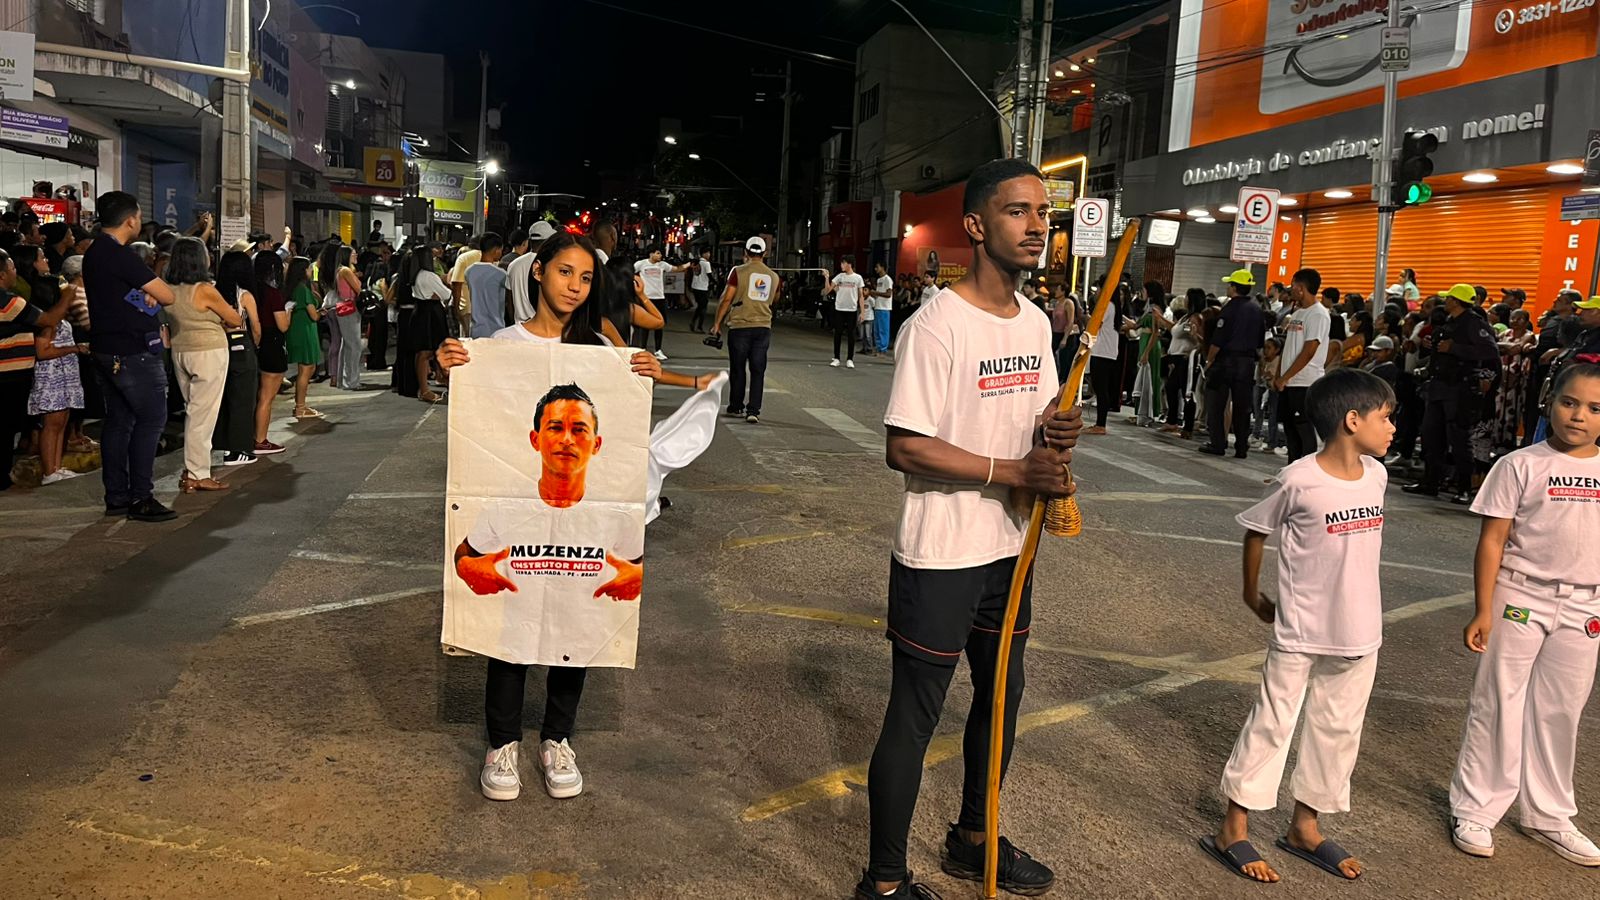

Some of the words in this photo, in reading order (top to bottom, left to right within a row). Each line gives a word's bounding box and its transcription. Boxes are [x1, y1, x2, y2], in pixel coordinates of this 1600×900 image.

[1383, 48, 1408, 59] 010
[12, 116, 40, 125] OLIVEIRA
[17, 111, 37, 119] ENOCK
[1268, 151, 1293, 172] de
[1298, 137, 1384, 166] confianç
[1462, 103, 1546, 140] nome!
[377, 169, 393, 180] 20
[420, 174, 457, 186] LOJÃO
[31, 203, 55, 212] Coca-Cola
[1252, 201, 1263, 217] E
[440, 211, 462, 220] ÚNICO
[1087, 207, 1095, 220] E
[939, 264, 968, 276] mais
[1552, 488, 1598, 497] GRADUADO
[1331, 520, 1370, 533] MONITOR
[510, 545, 604, 559] MUZENZA
[512, 561, 570, 569] INSTRUTOR
